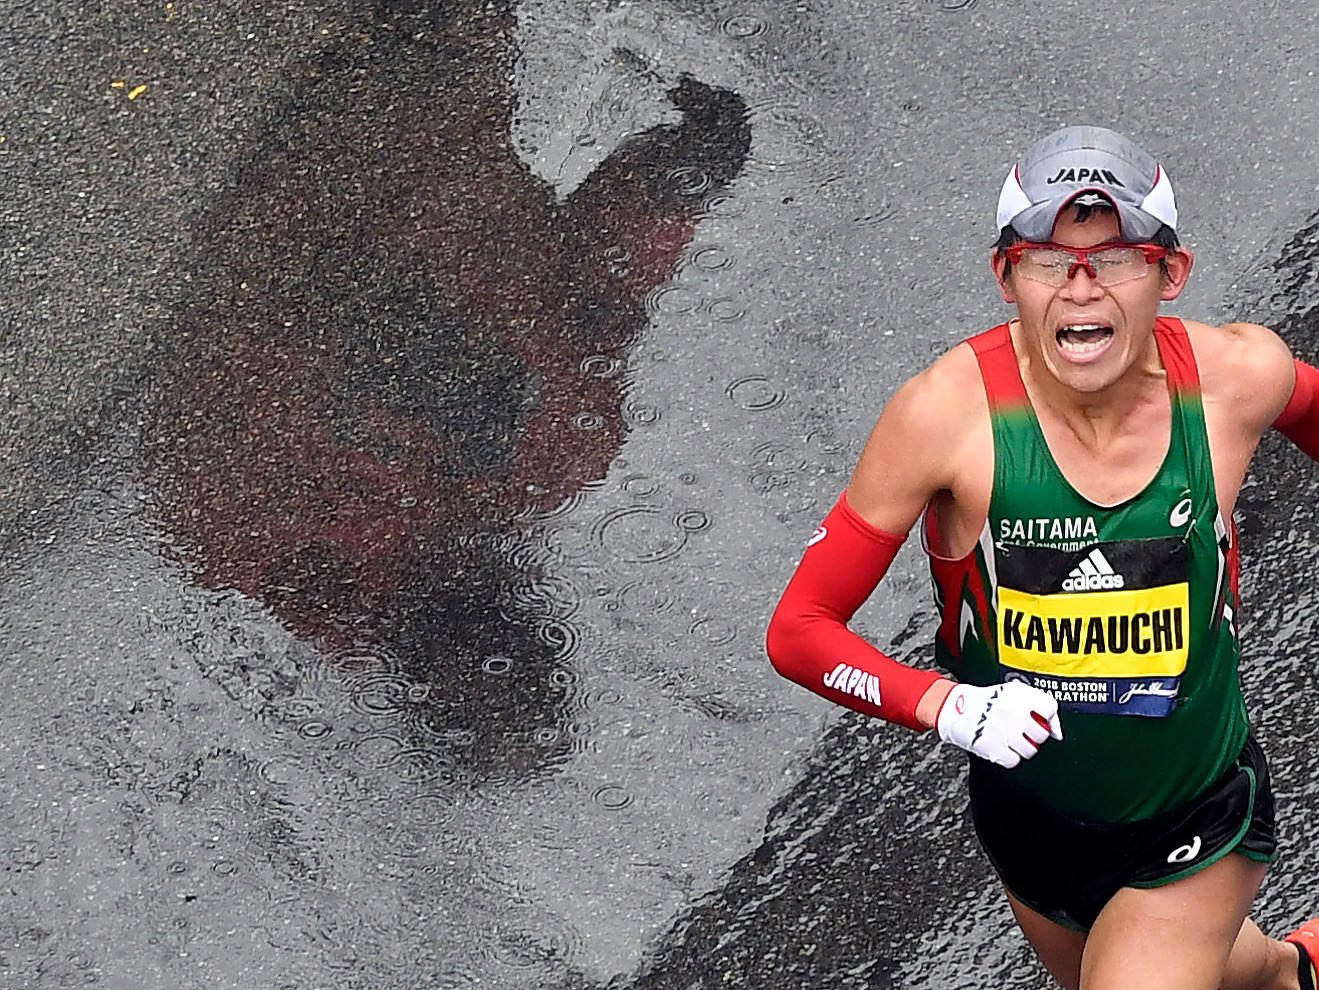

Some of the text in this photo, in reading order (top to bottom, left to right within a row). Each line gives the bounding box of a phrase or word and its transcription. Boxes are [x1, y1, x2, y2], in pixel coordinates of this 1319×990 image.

[1047, 168, 1125, 188] JAPAN
[1000, 516, 1098, 540] SAITAMA
[1062, 573, 1124, 591] adidas
[1003, 607, 1183, 655] KAWAUCHI
[823, 663, 882, 707] JAPAN
[1033, 677, 1107, 692] 2018 BOSTON
[1047, 690, 1108, 702] RATHON
